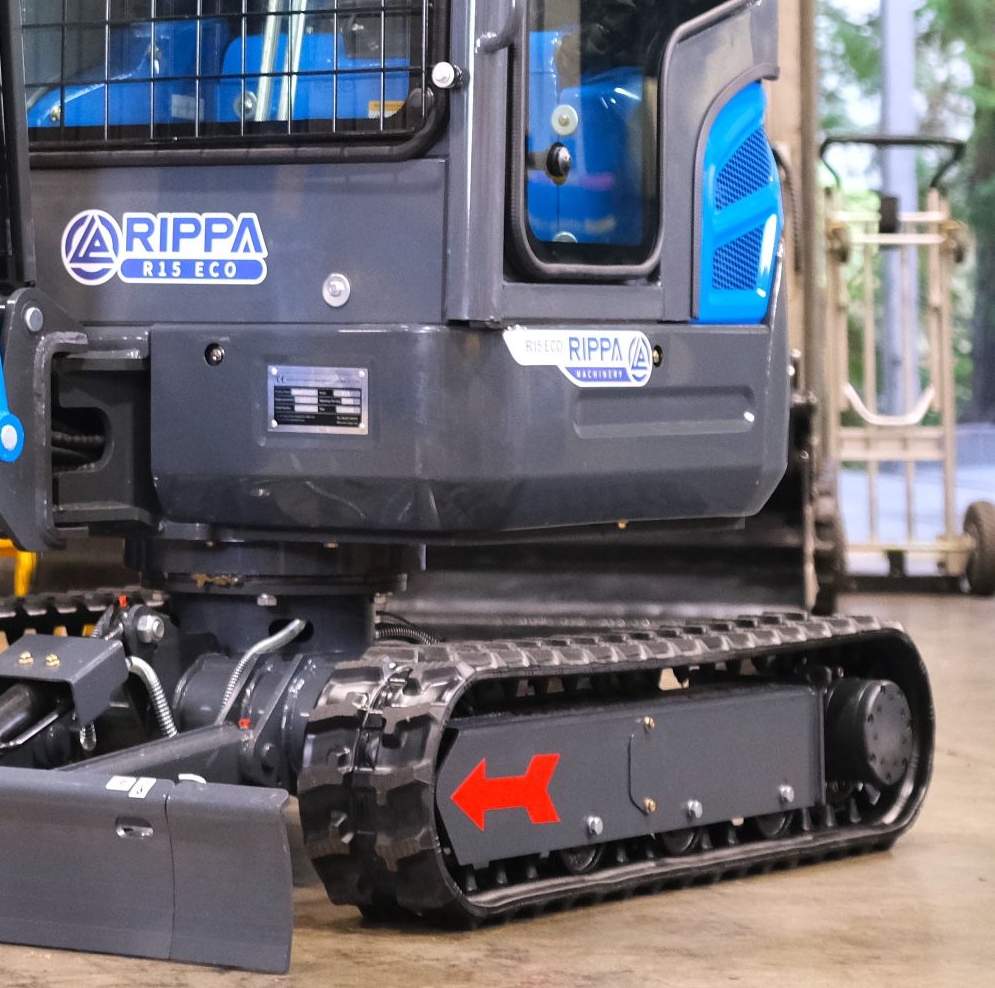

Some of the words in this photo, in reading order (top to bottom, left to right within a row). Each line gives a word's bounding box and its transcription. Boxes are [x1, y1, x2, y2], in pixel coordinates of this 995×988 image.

[125, 217, 263, 253] RIPPA
[142, 261, 182, 278] R15
[194, 261, 237, 278] ECO
[525, 340, 543, 353] R15
[545, 340, 563, 353] ECO
[568, 337, 624, 361] RIPPA
[576, 369, 624, 380] MACHINERY
